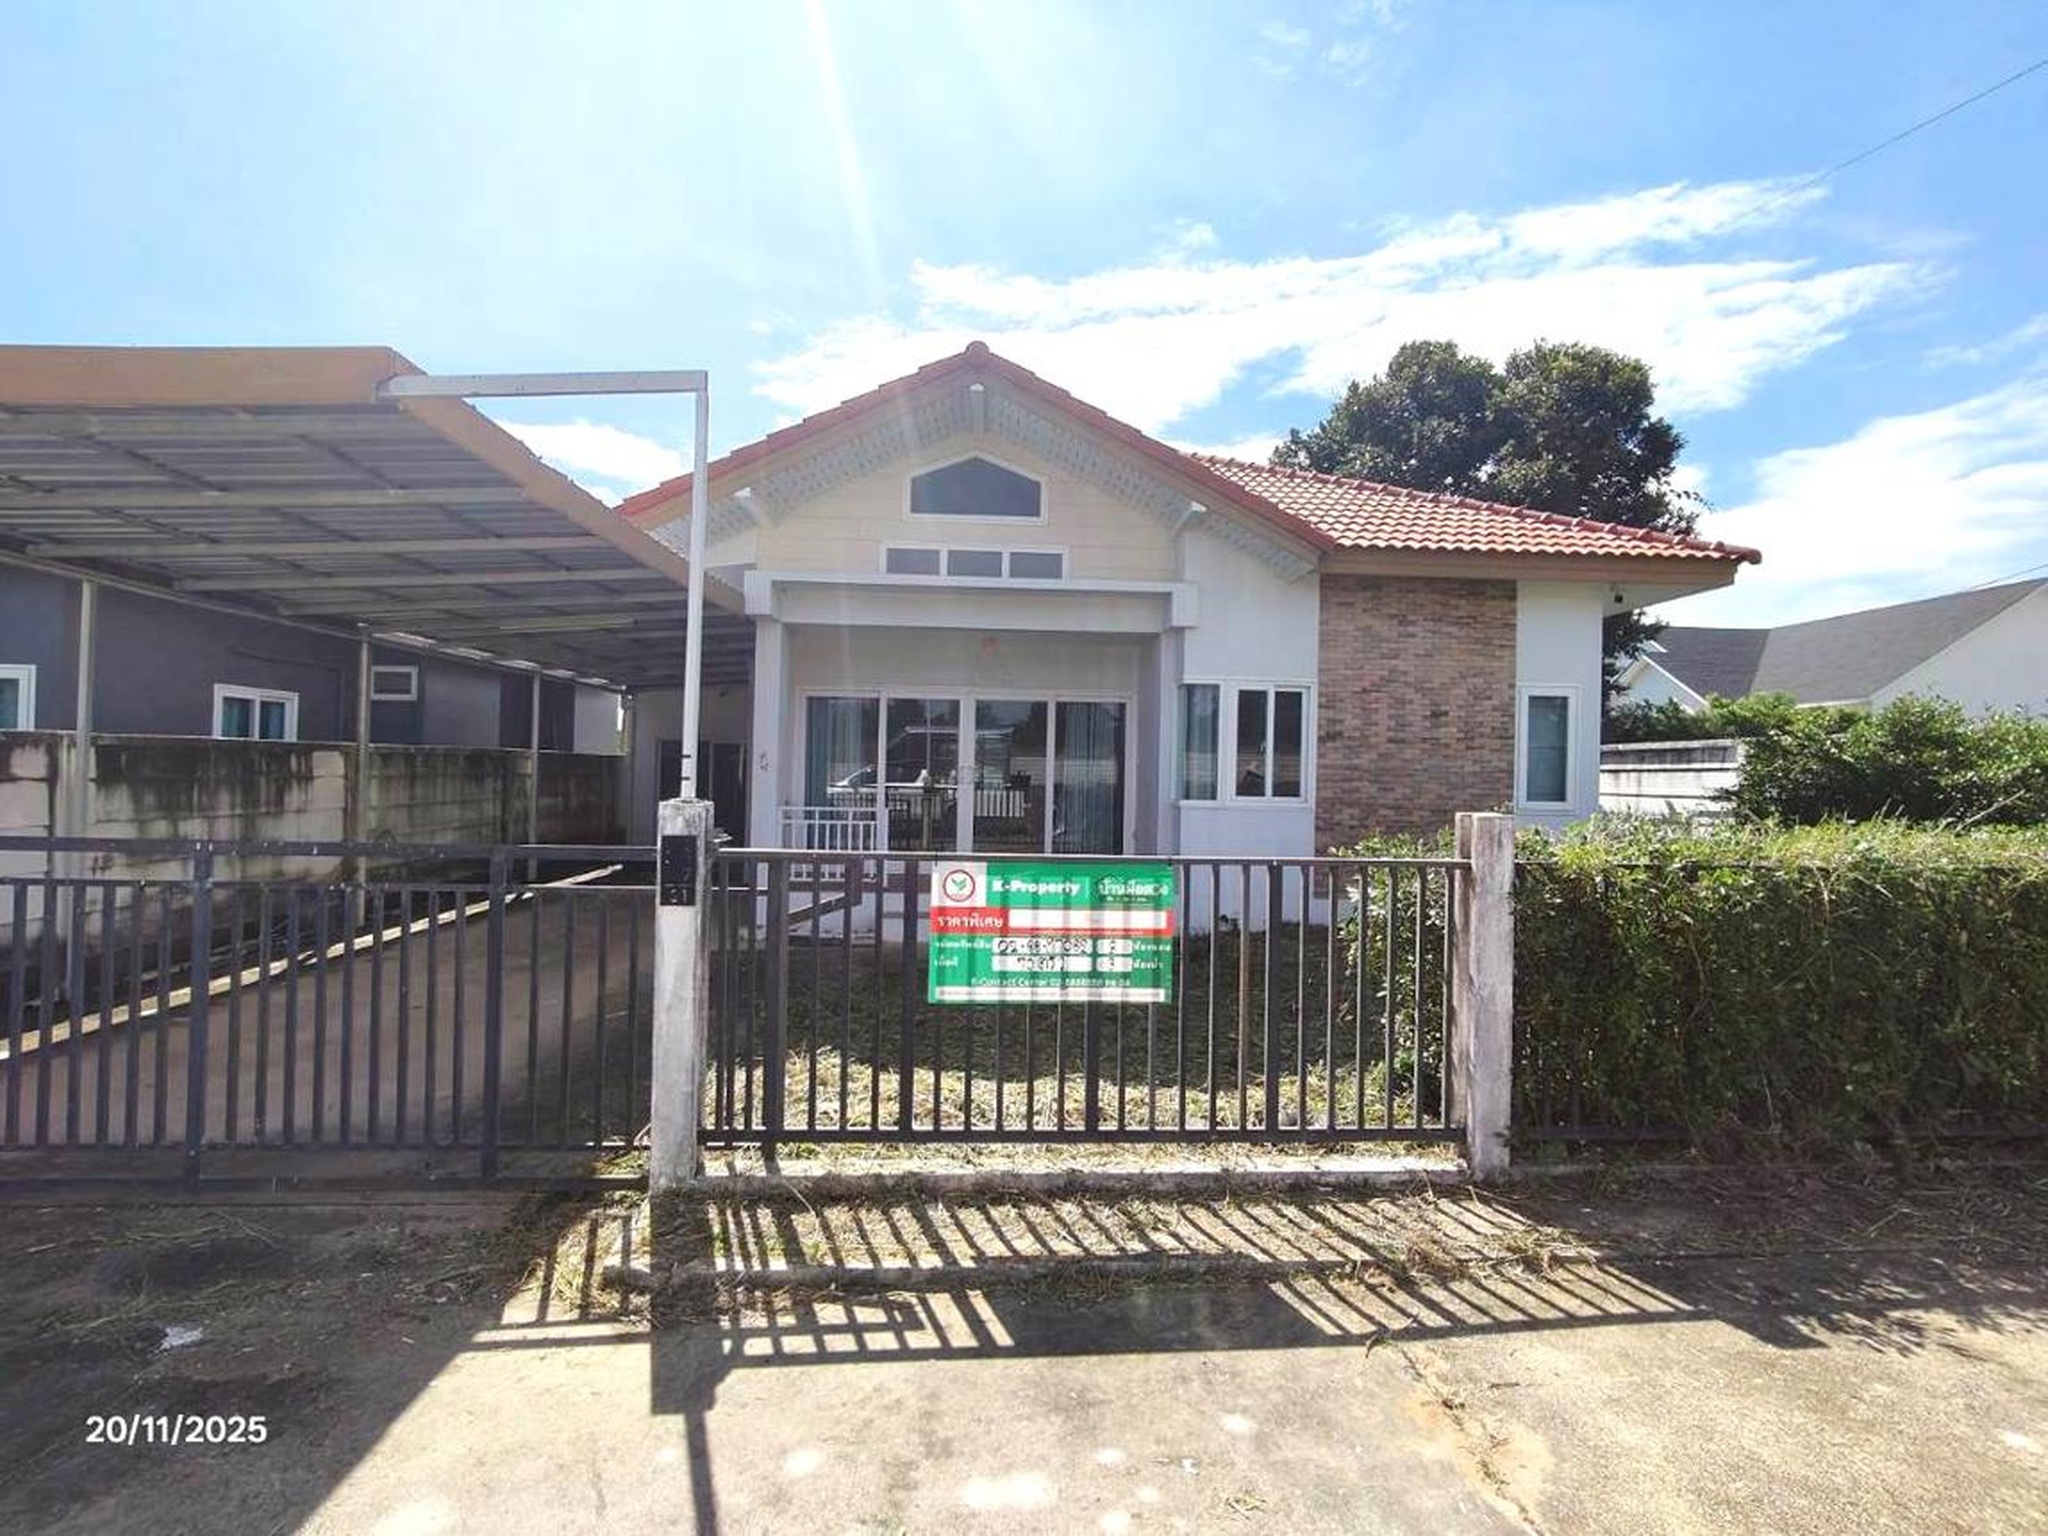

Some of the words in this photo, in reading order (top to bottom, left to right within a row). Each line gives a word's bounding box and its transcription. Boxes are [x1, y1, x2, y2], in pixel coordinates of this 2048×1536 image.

[992, 879, 1081, 897] K-Property
[937, 912, 1003, 929] ราคาพิเศษ
